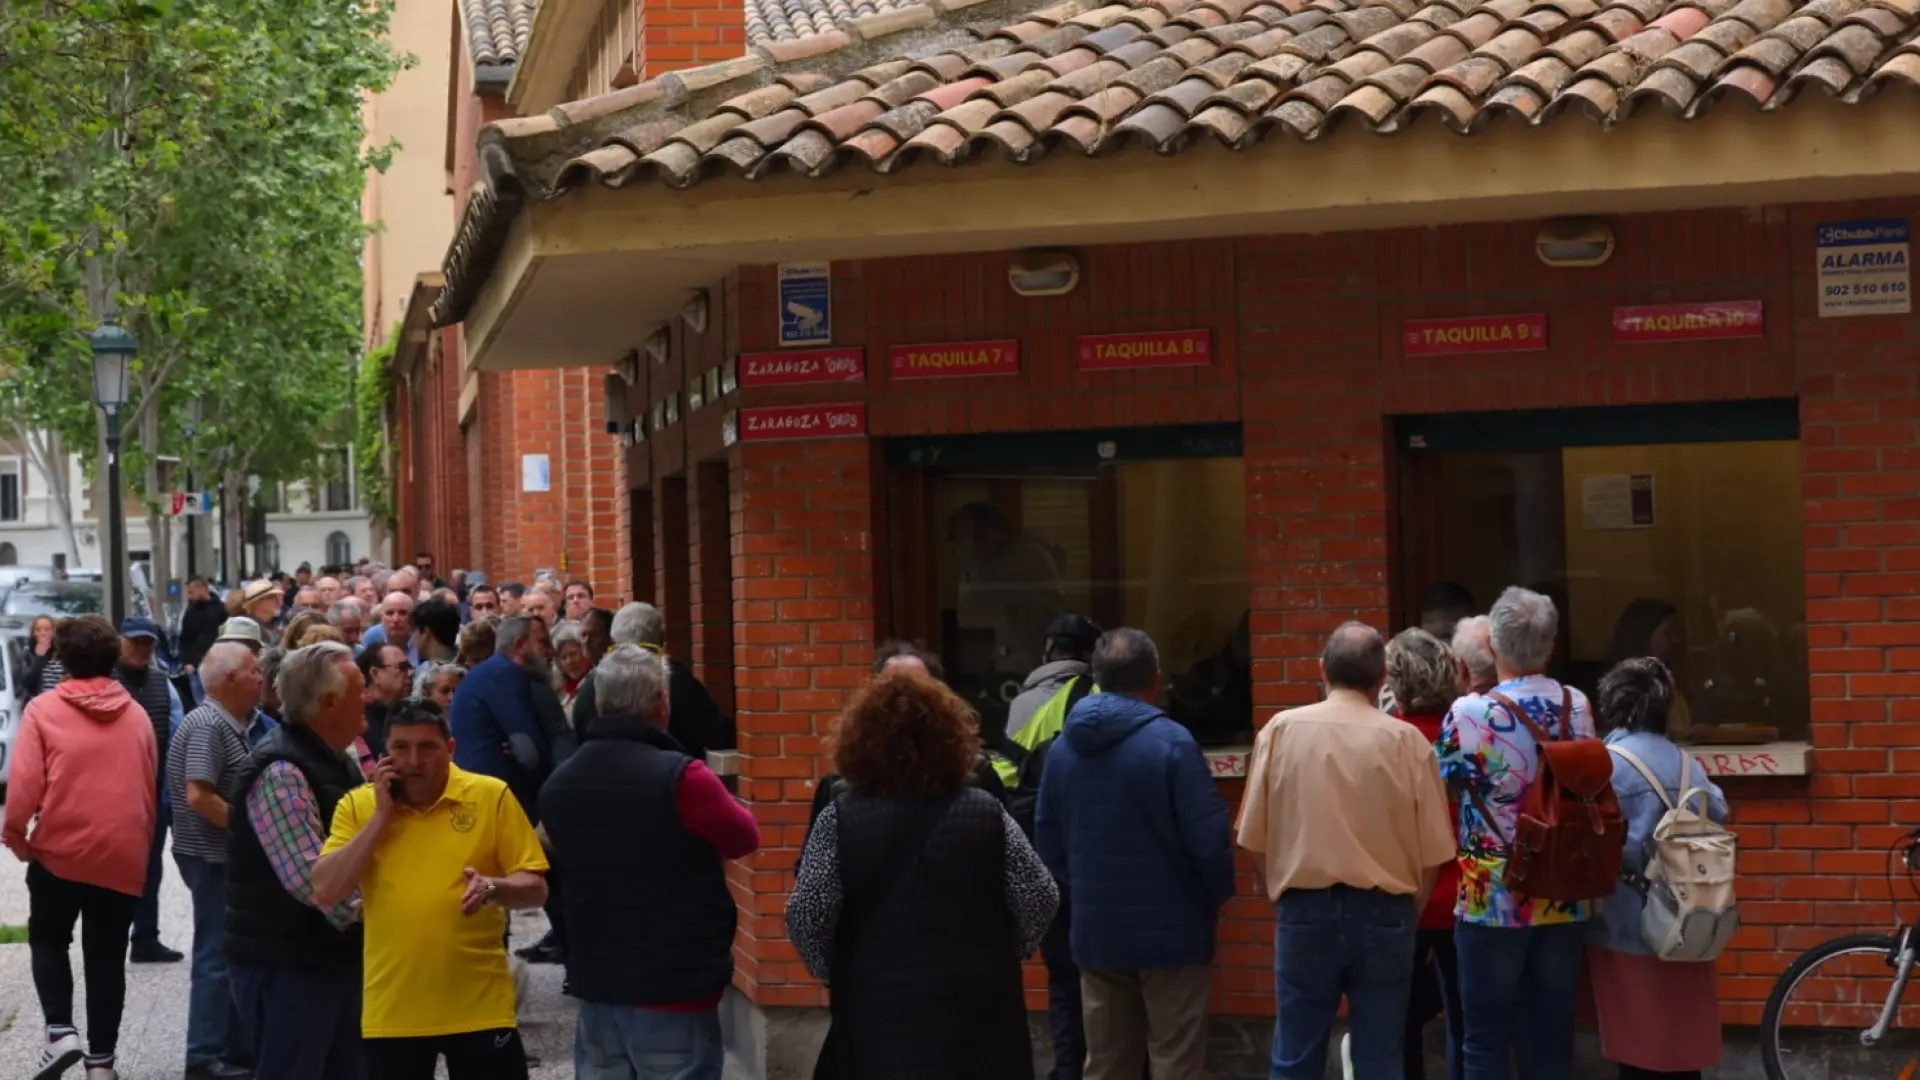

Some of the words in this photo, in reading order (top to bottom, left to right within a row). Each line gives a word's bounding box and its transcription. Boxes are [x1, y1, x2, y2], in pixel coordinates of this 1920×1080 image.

[1822, 251, 1905, 268] ALARMA
[1825, 285, 1849, 296] 902
[1853, 283, 1877, 295] 510
[1881, 282, 1905, 293] 610
[1632, 313, 1721, 333] TAQUILLA
[1422, 324, 1513, 345] TAQUILLA
[1516, 323, 1528, 340] 9
[907, 349, 990, 369] TAQUILLA
[991, 348, 1001, 364] 7
[1094, 339, 1179, 359] TAQUILLA
[1182, 338, 1194, 355] 8
